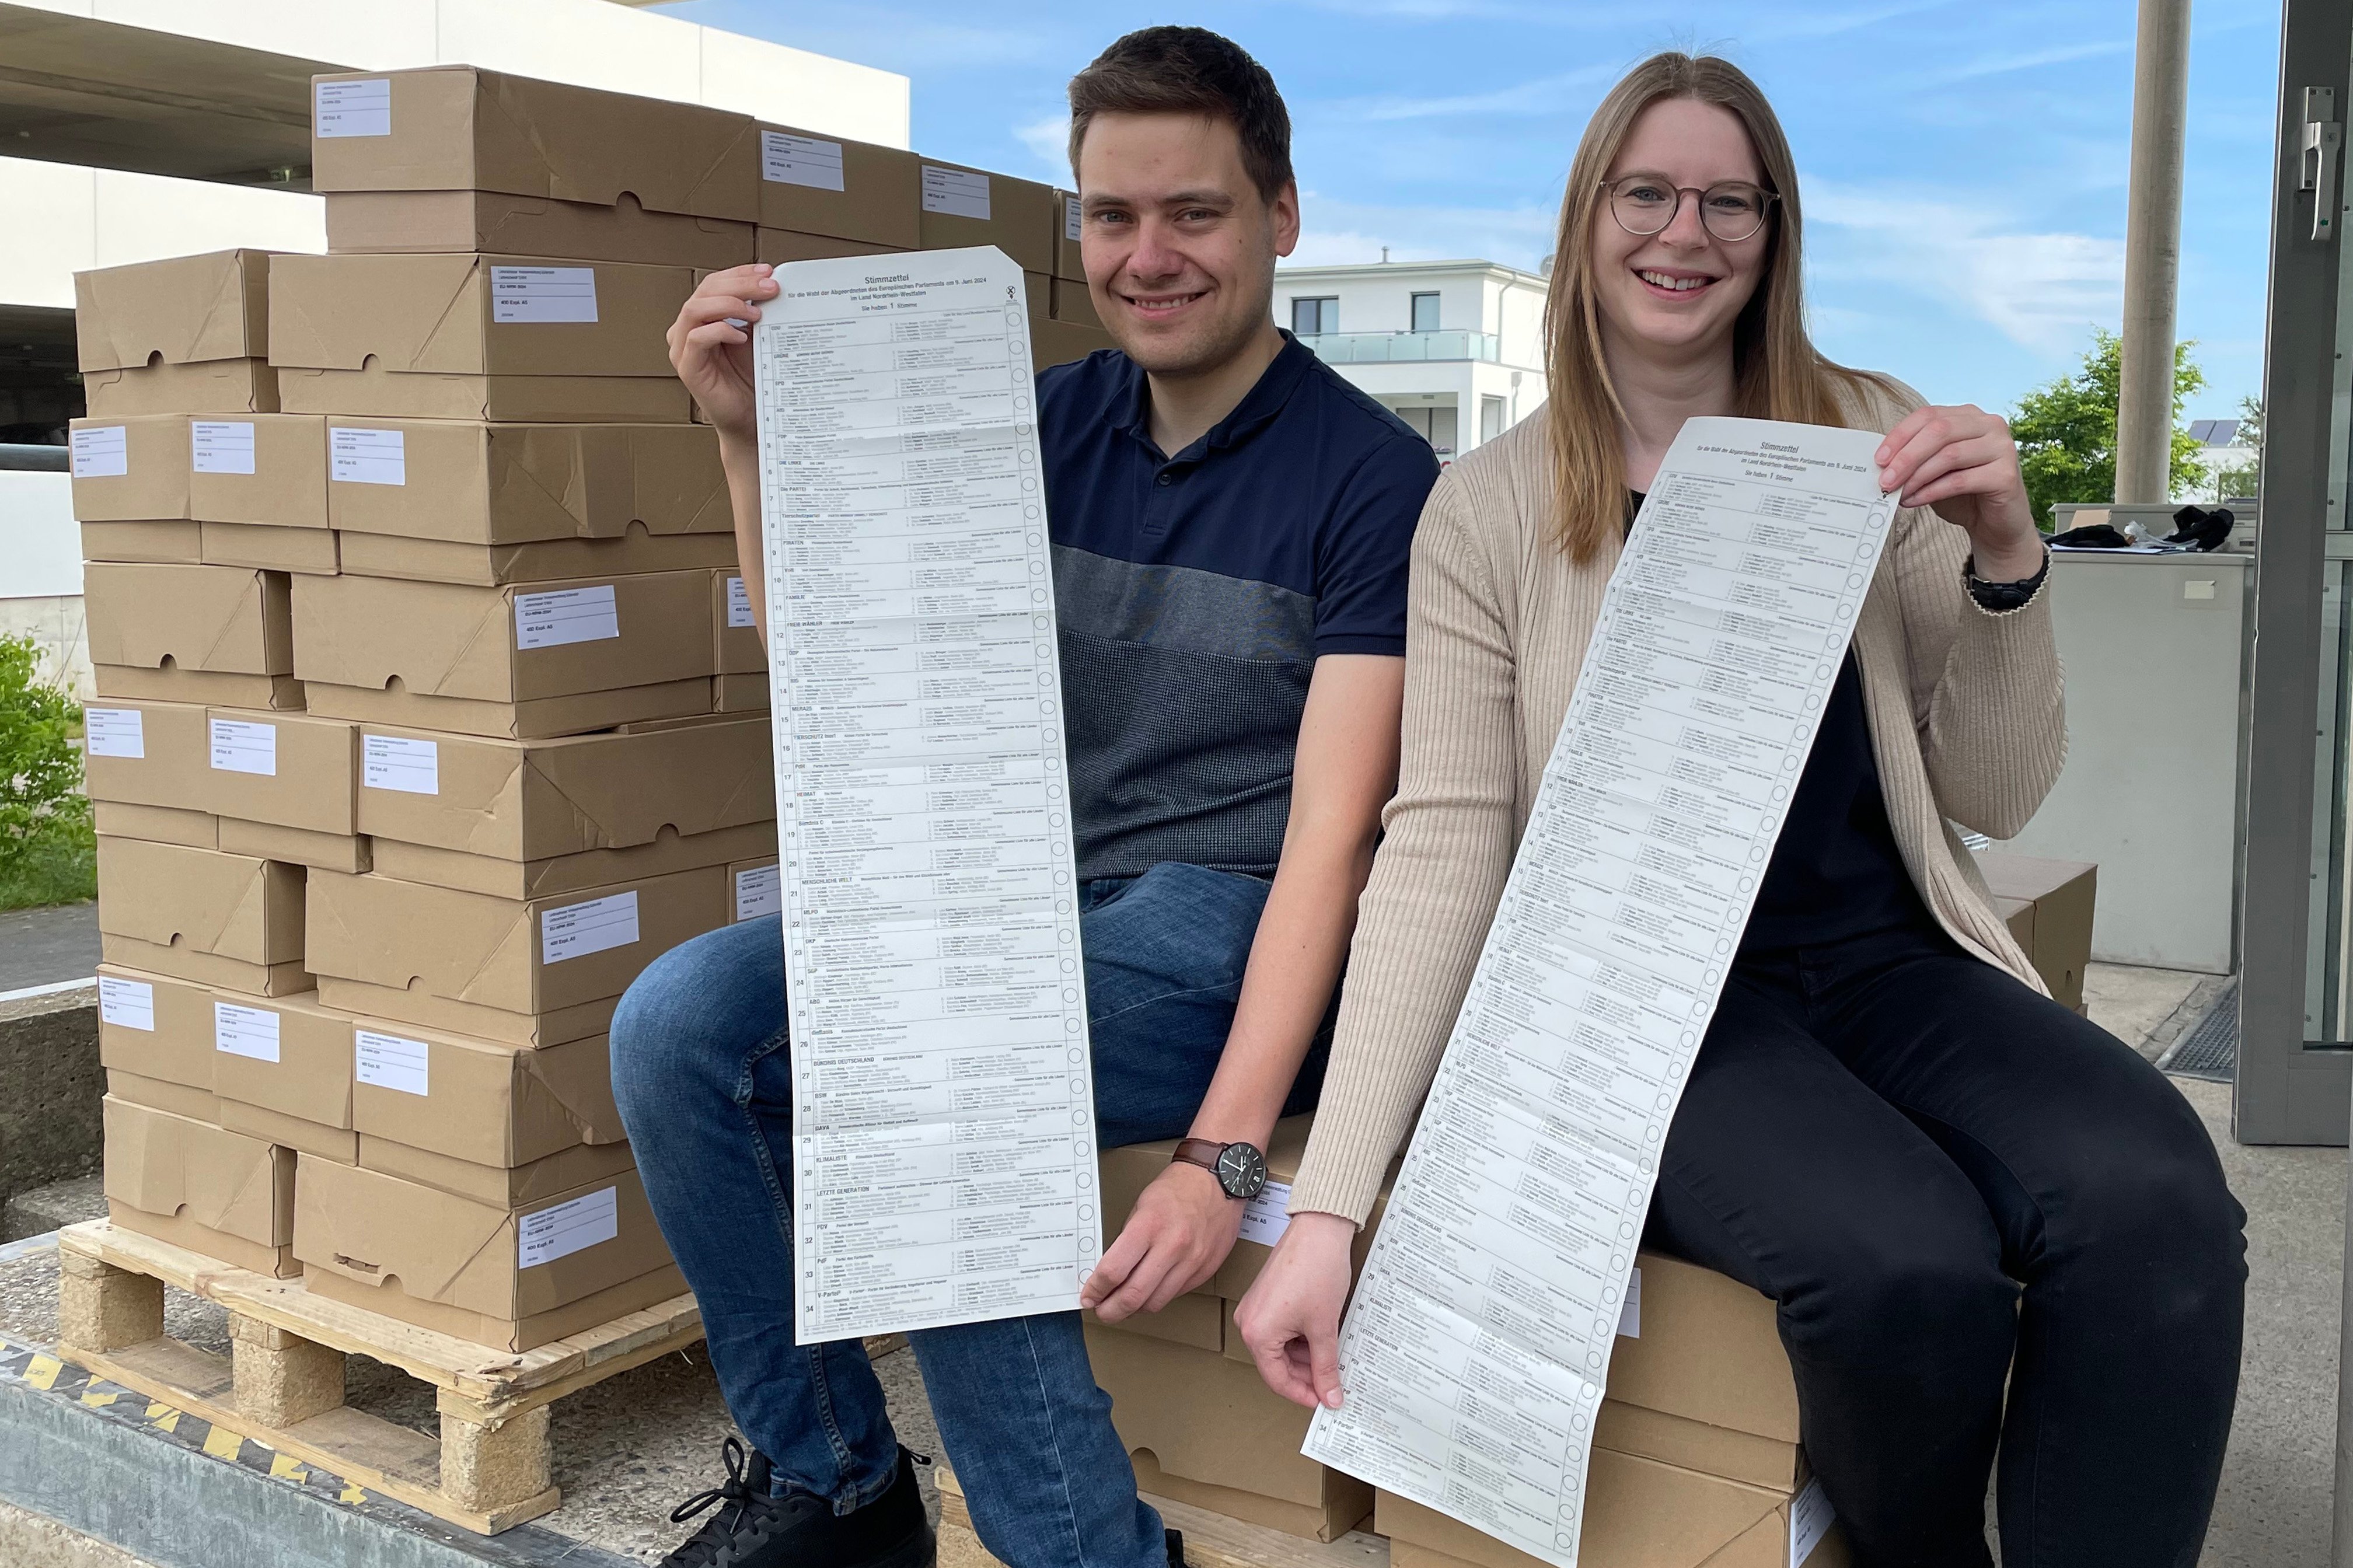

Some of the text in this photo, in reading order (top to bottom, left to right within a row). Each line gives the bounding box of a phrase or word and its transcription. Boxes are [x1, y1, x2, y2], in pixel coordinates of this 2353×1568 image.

[865, 274, 909, 284] Stimmzettel
[1760, 442, 1799, 453] Stimmzettel
[837, 1186, 870, 1195] GENERATION
[1360, 1328, 1398, 1351] LETZTE GENERATION
